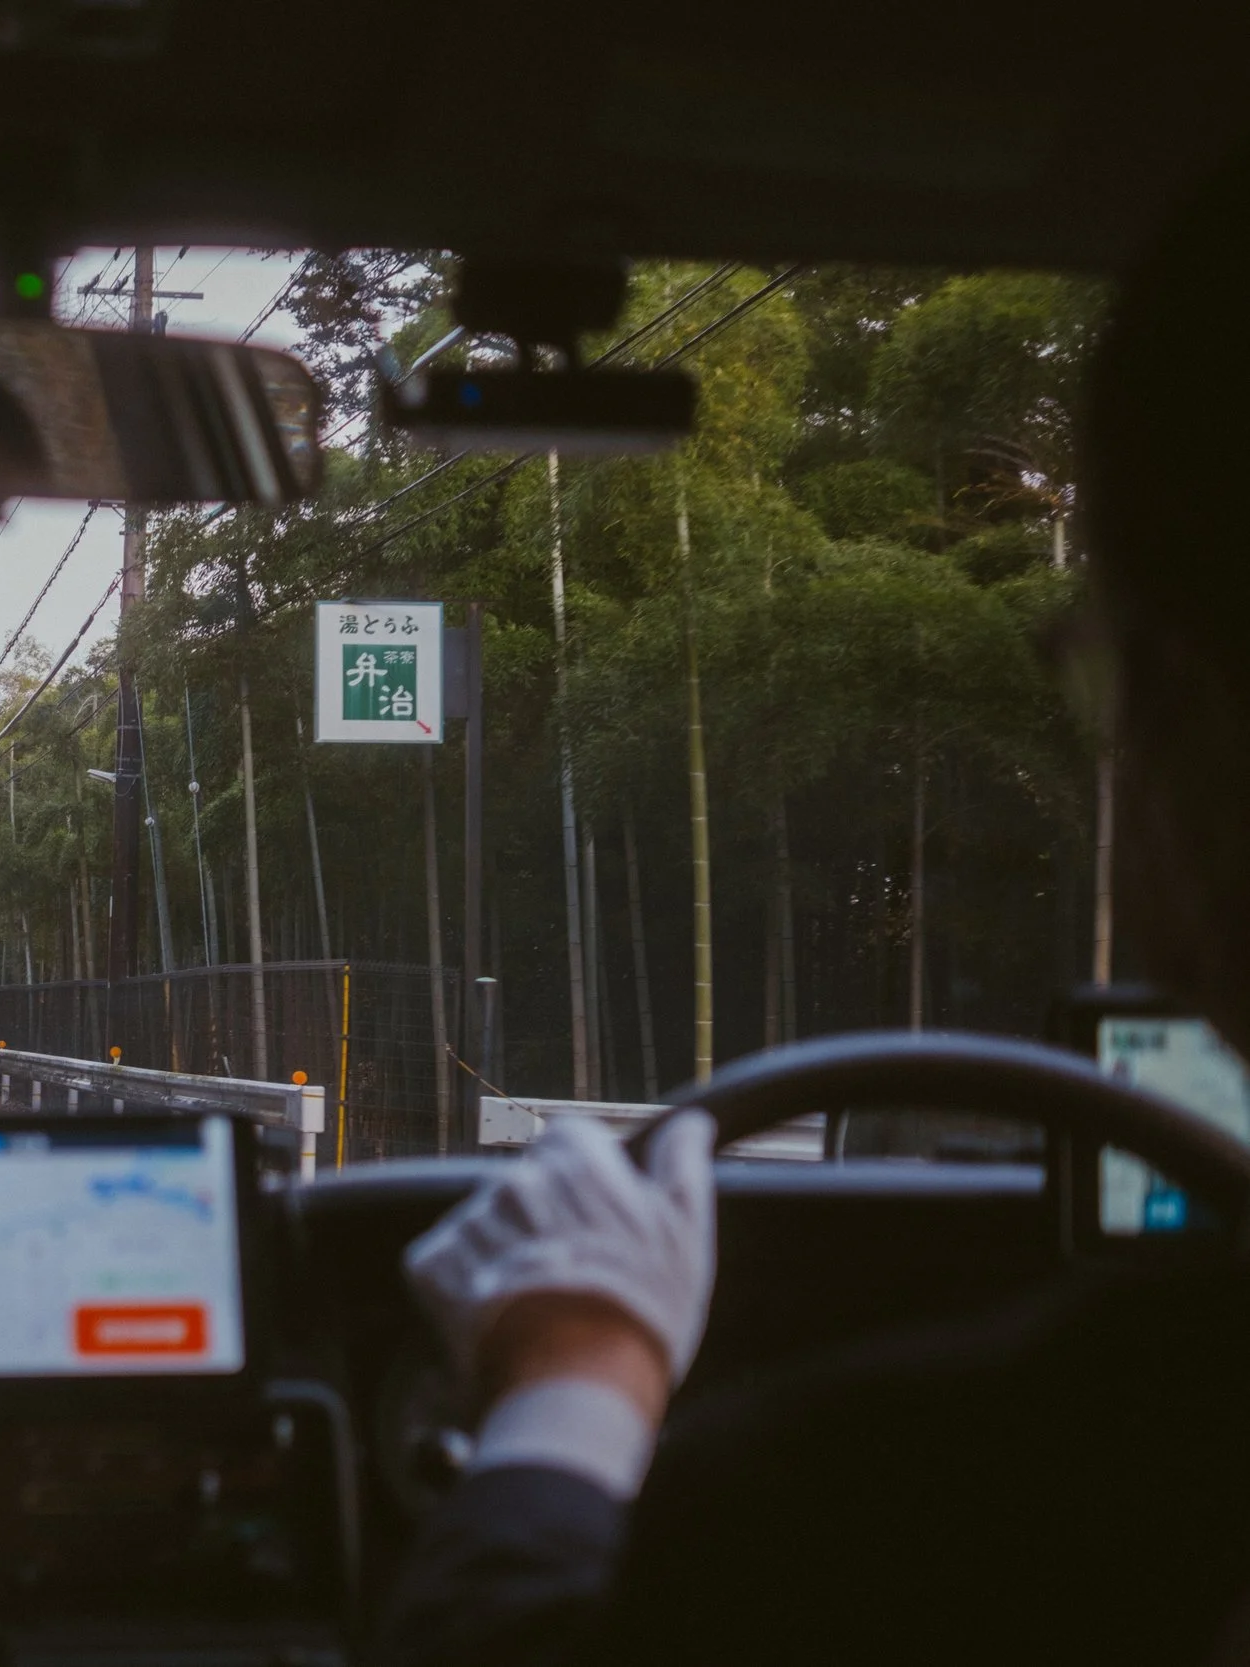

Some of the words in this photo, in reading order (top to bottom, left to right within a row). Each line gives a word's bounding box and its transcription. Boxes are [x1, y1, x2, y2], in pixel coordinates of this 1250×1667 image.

[339, 614, 419, 635] 湯とうふ
[383, 650, 415, 665] 茶寮
